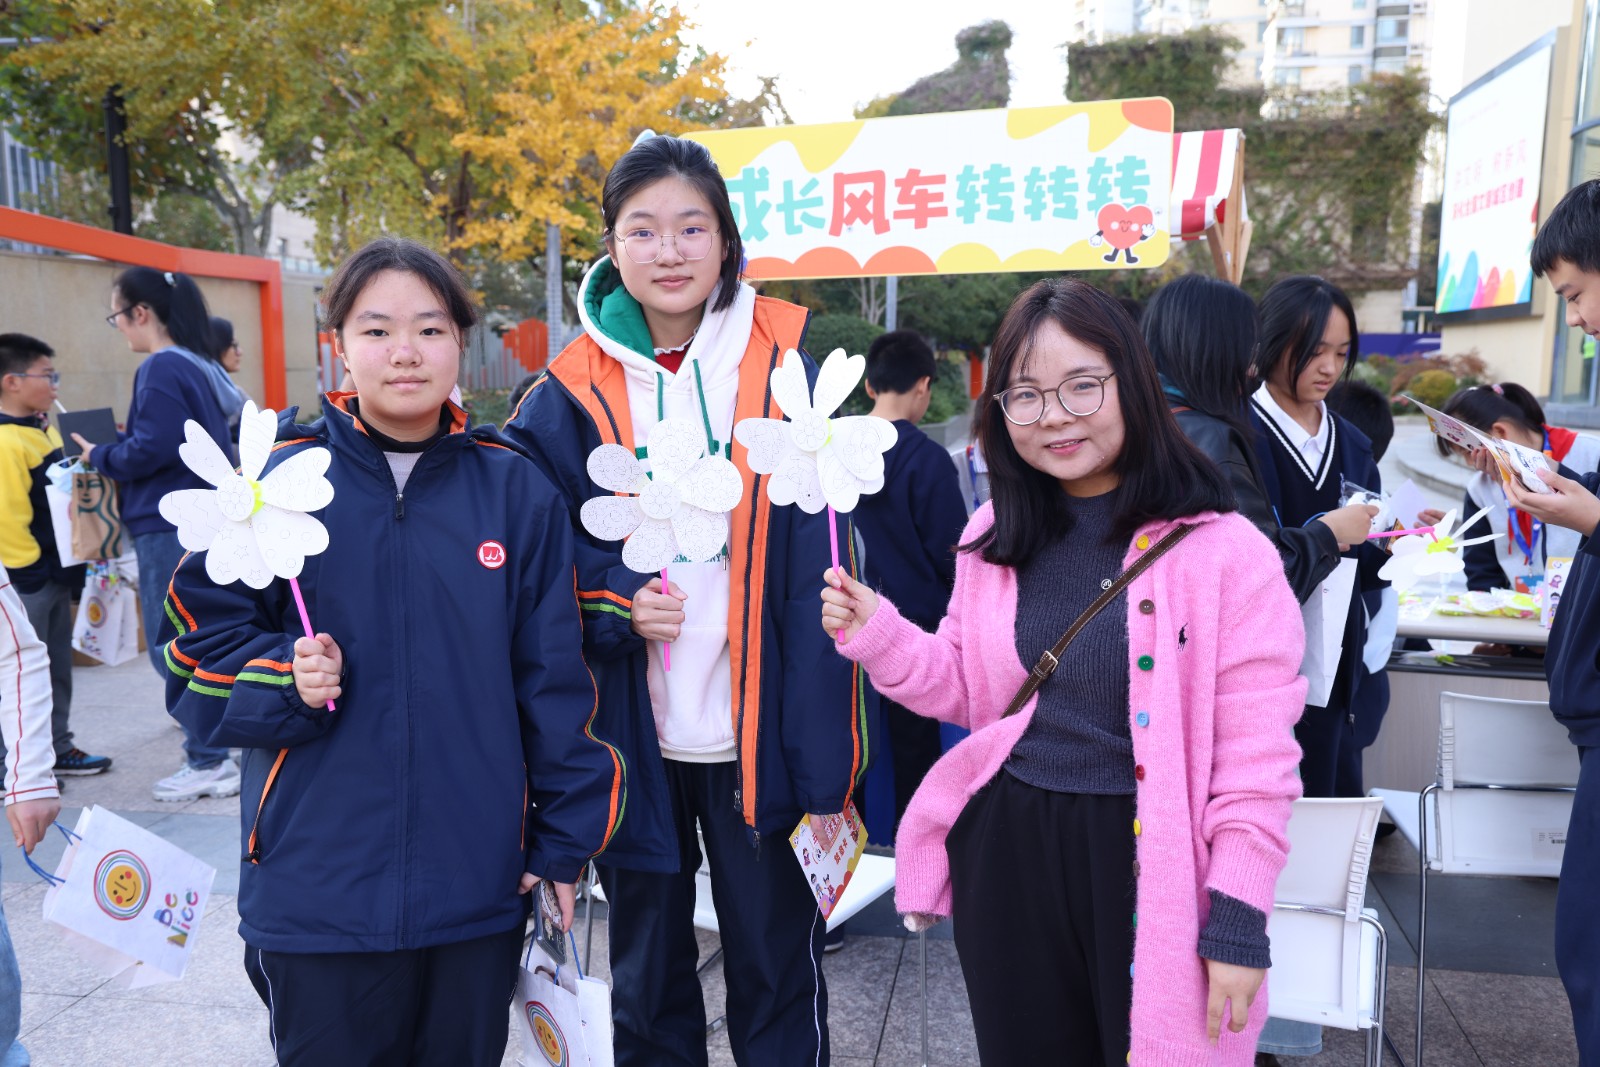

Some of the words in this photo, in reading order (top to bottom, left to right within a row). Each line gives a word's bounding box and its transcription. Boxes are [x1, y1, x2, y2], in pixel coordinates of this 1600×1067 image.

[725, 156, 1150, 242] 成长风车转转转
[154, 893, 178, 927] Be
[167, 891, 198, 948] Nice
